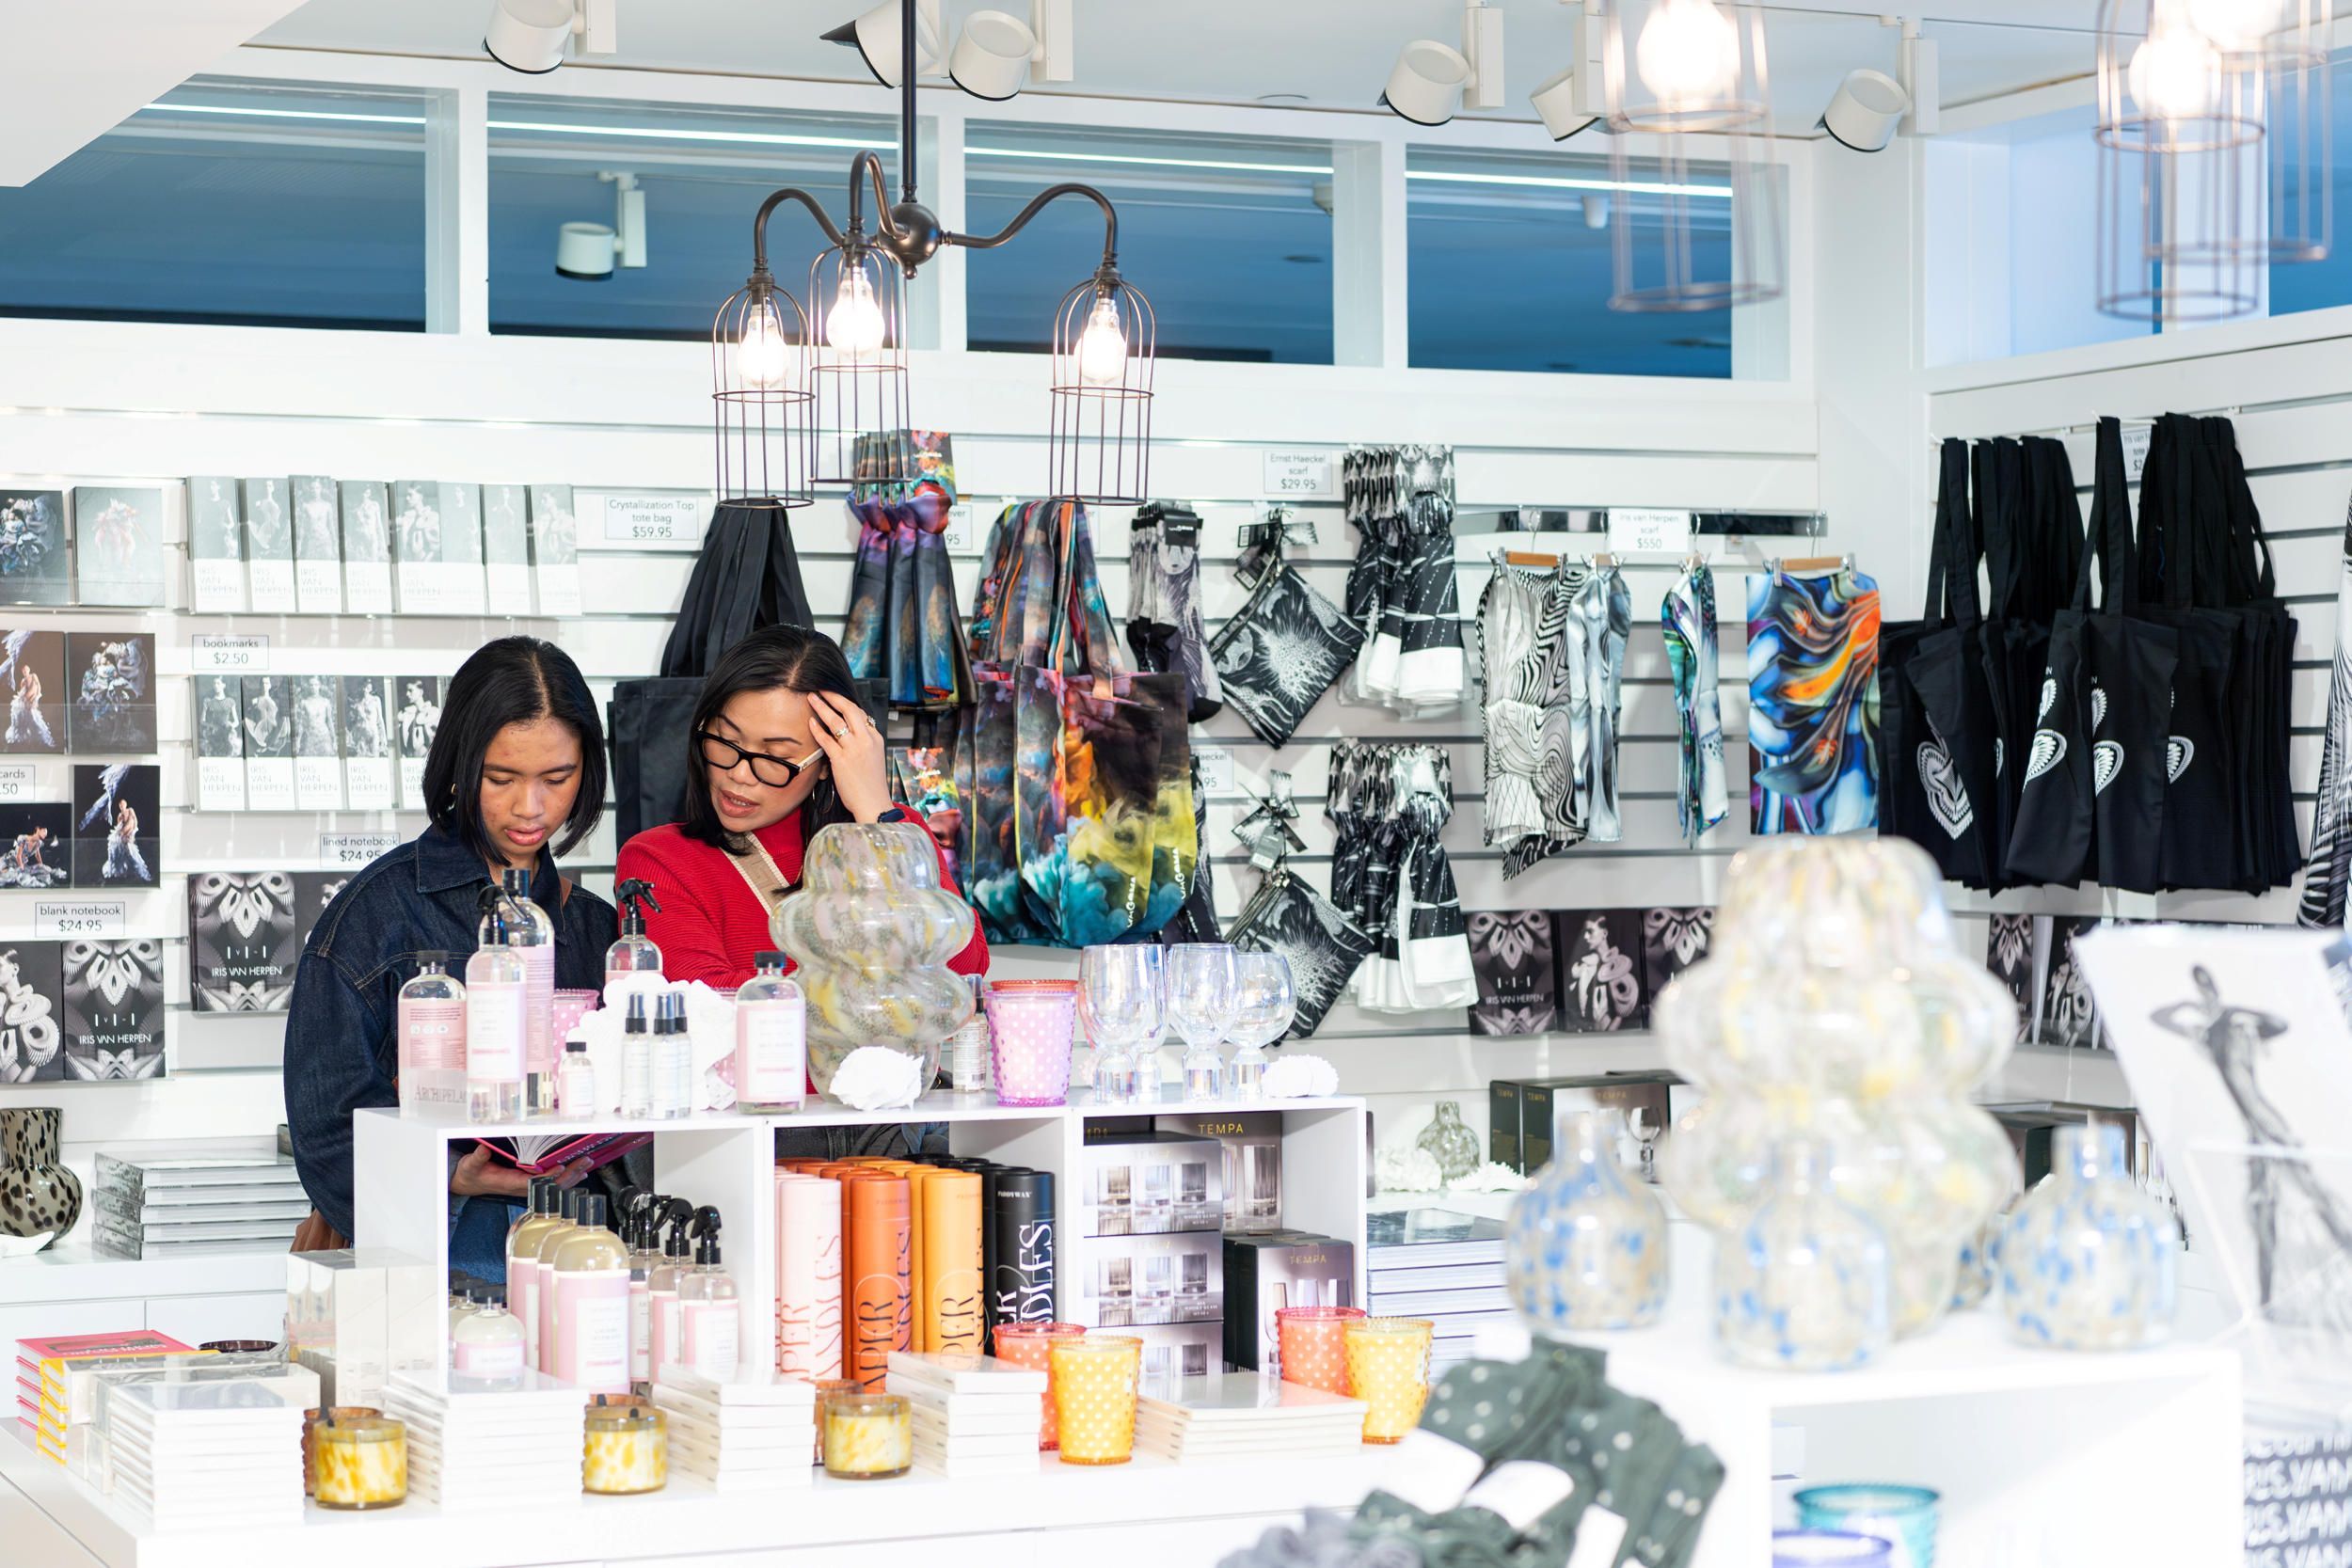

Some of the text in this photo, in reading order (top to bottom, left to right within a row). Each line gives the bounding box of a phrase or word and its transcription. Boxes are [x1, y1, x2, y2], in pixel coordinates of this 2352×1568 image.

[1288, 466, 1309, 475] scarf
[1280, 478, 1317, 489] $29.95
[609, 499, 694, 512] Crystallization Top
[632, 513, 672, 525] tote bag
[632, 526, 673, 538] $59.95
[1640, 526, 1660, 534] scarf
[1637, 538, 1662, 549] $550
[203, 638, 259, 648] bookmarks
[214, 652, 248, 664] $2.50
[323, 835, 399, 847] lined notebook
[40, 905, 121, 915] blank notebook
[58, 919, 103, 932] $24.95
[212, 965, 282, 977] IRIS VAN HERPEN
[79, 1033, 151, 1045] IRIS VAN HERPEN
[1198, 1123, 1244, 1135] TEMPA
